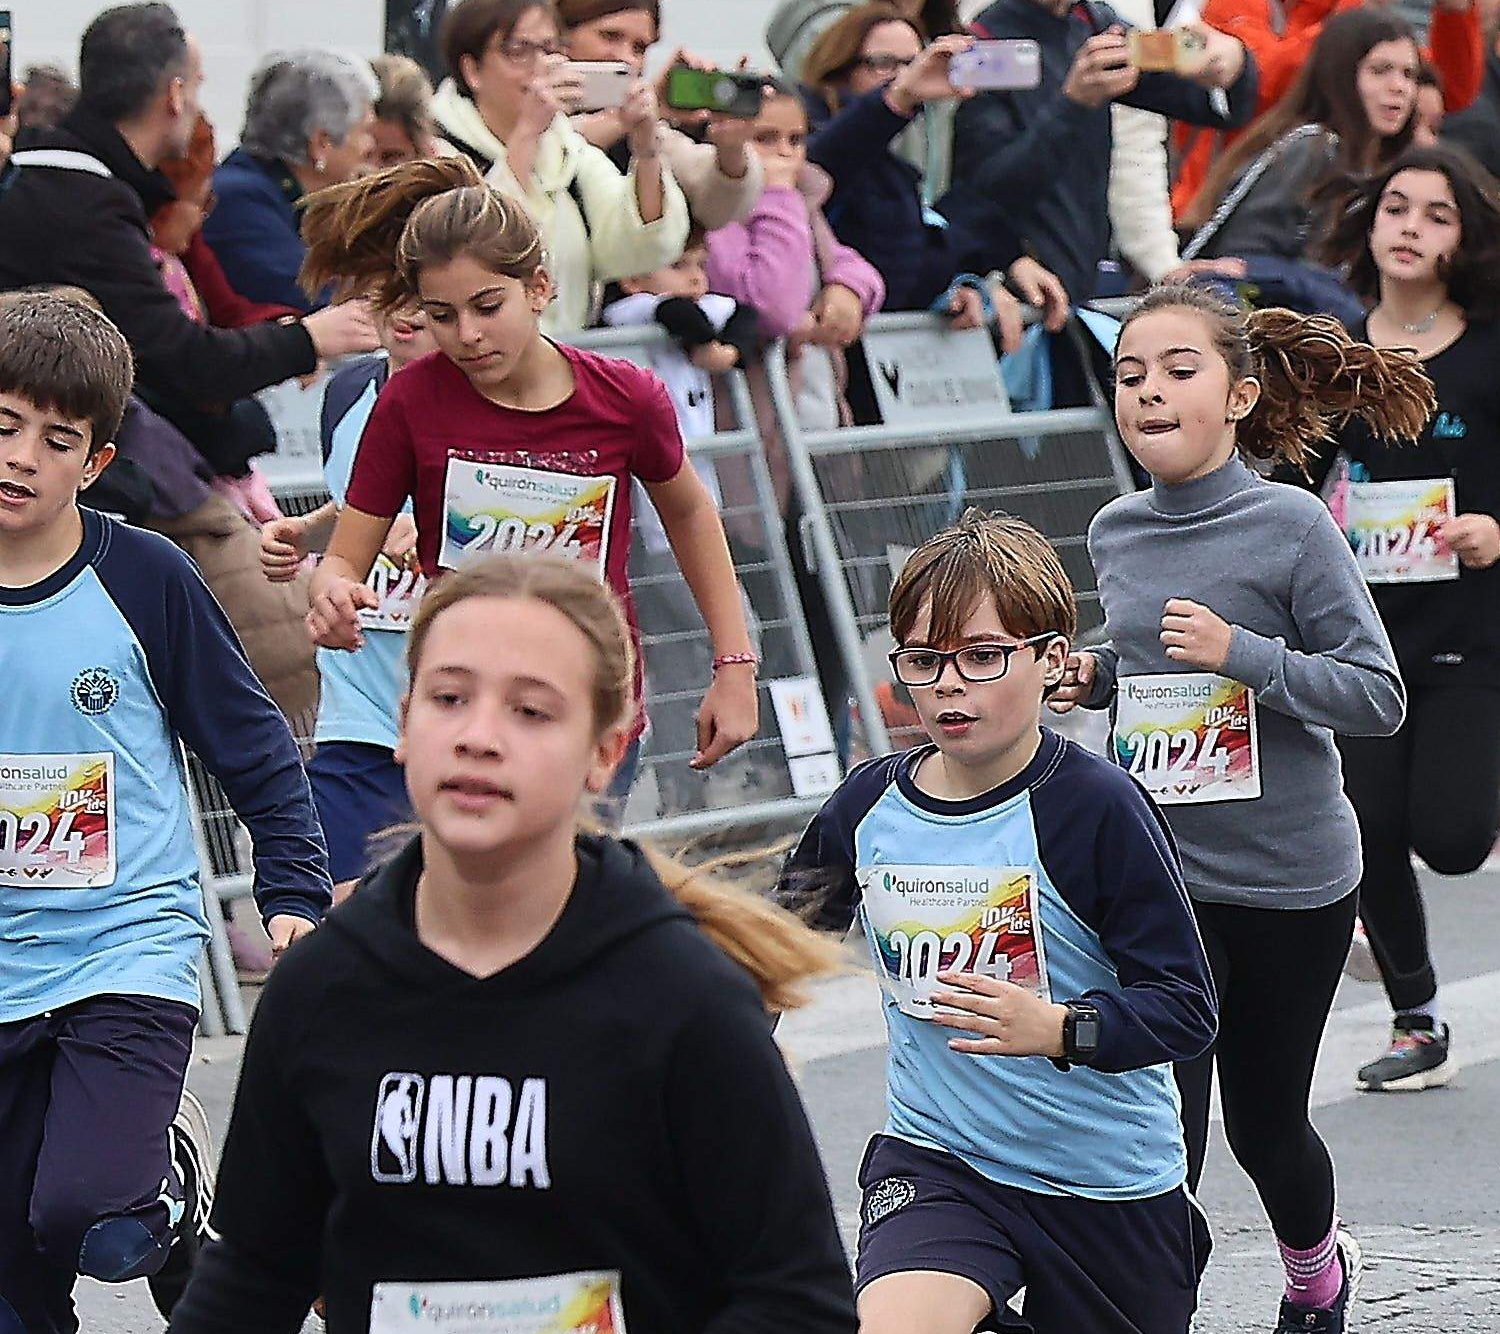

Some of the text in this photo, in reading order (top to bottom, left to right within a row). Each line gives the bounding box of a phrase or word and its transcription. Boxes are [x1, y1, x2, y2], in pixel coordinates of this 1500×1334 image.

[1128, 728, 1228, 779] 2024
[0, 809, 87, 865] 024
[895, 878, 989, 897] quirónsalud
[909, 897, 955, 907] Healthcare
[889, 930, 1014, 990] 2024
[424, 1074, 552, 1190] NBA
